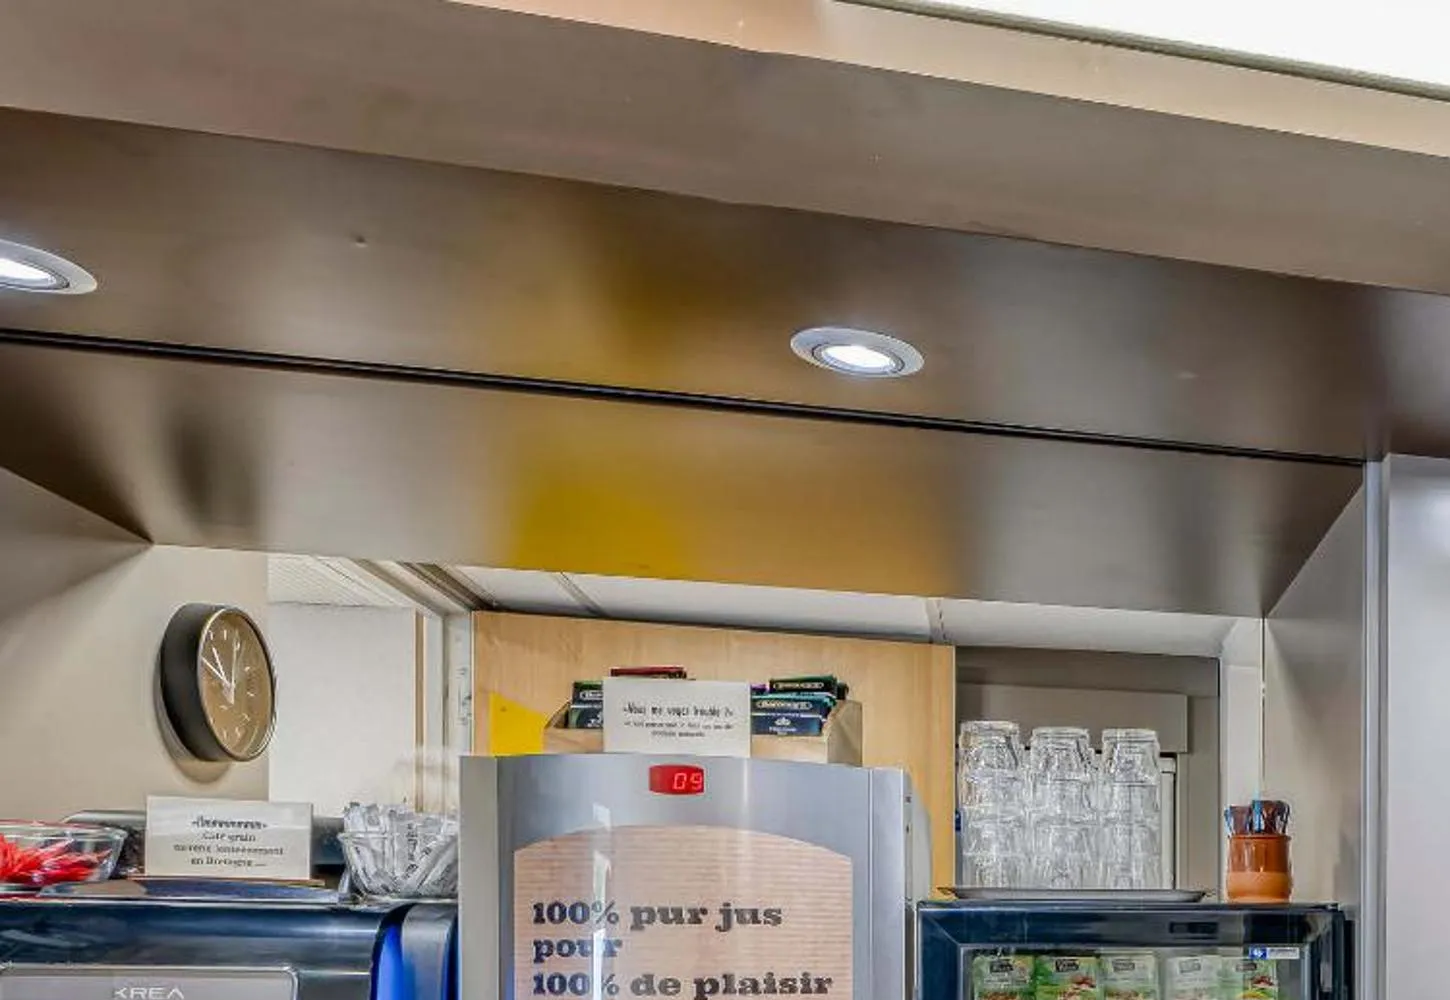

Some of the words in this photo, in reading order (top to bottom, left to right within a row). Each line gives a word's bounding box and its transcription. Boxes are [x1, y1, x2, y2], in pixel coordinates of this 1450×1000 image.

[672, 772, 704, 790] 09
[532, 900, 619, 926] 100%
[630, 903, 708, 930] pur
[715, 901, 783, 932] jus
[532, 937, 623, 963] pour
[630, 972, 681, 997] de
[693, 971, 834, 1000] plaisir
